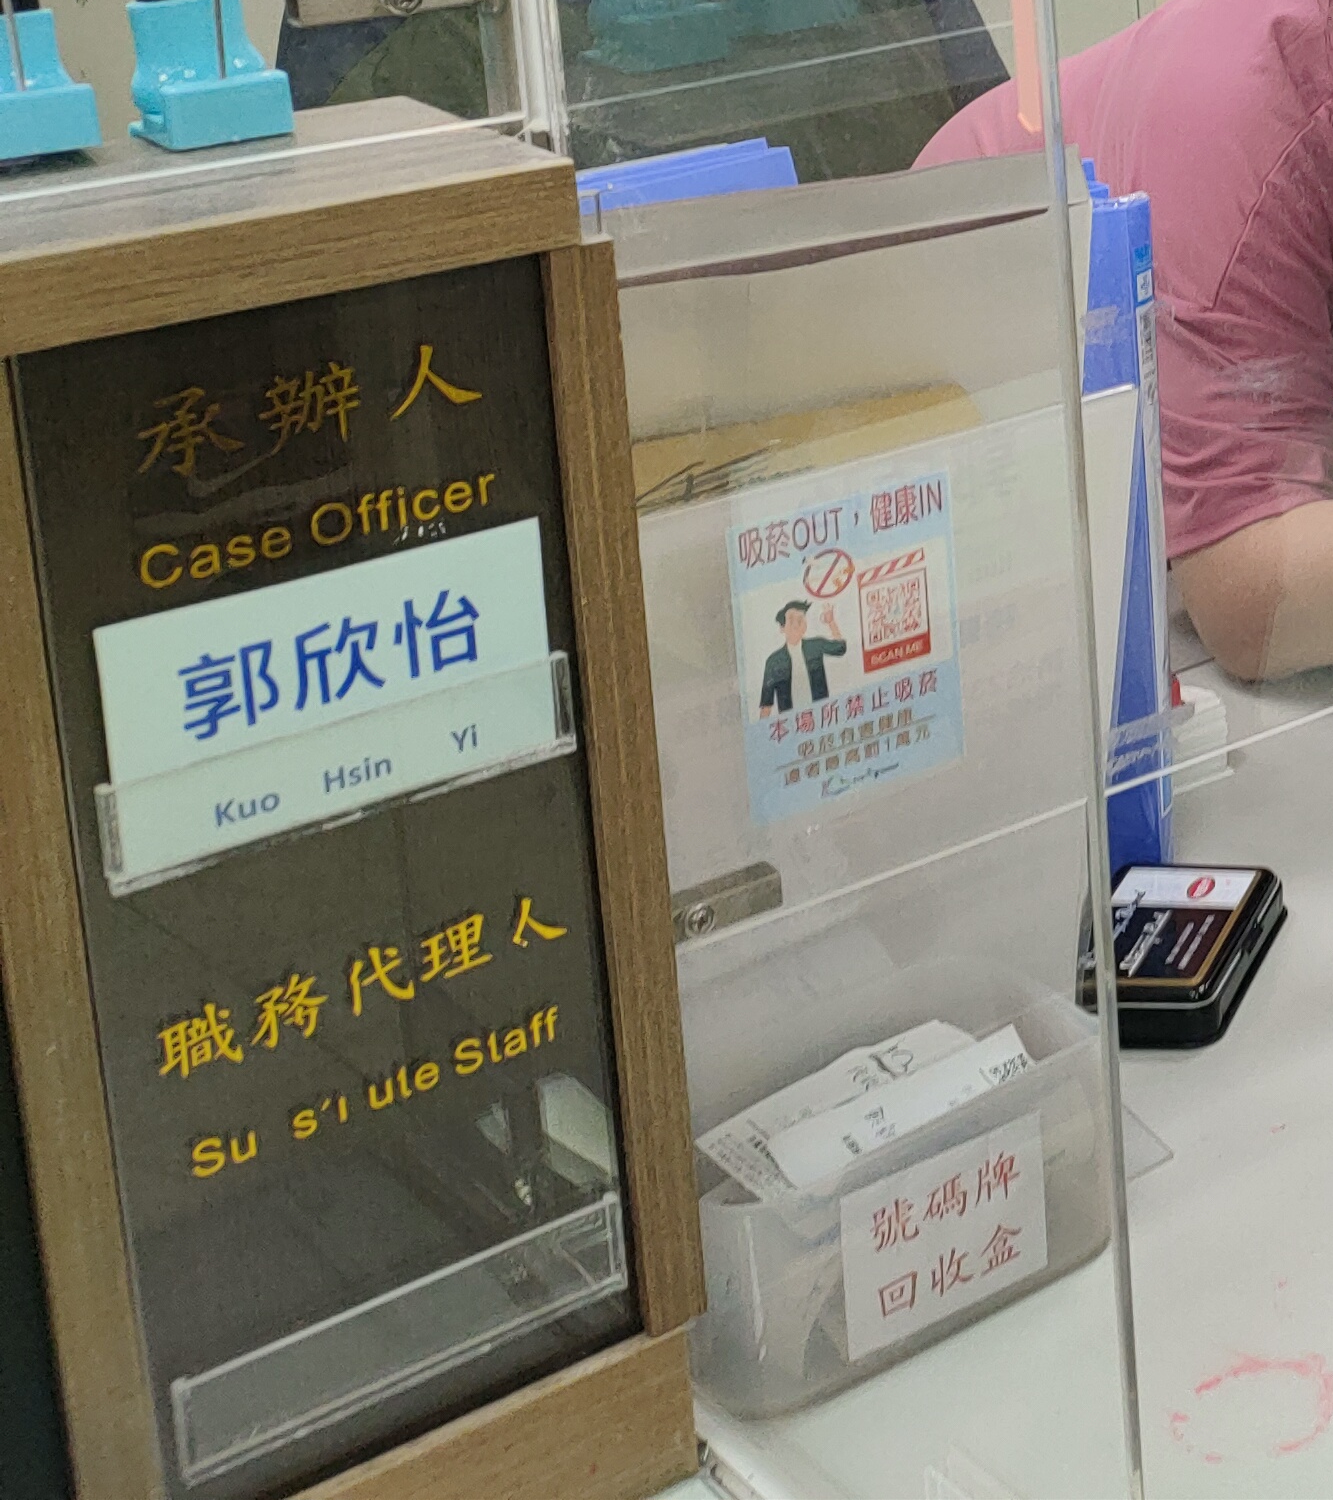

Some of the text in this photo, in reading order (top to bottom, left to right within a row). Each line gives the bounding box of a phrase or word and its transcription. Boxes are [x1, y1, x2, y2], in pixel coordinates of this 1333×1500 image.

[136, 343, 482, 477] 承辦人
[139, 471, 496, 590] Case Officer
[176, 589, 481, 741] 郭欣怡
[213, 723, 479, 828] Kuo Hsin Yi
[157, 897, 568, 1080] 職務代理人
[870, 1150, 1021, 1254] 號碼牌
